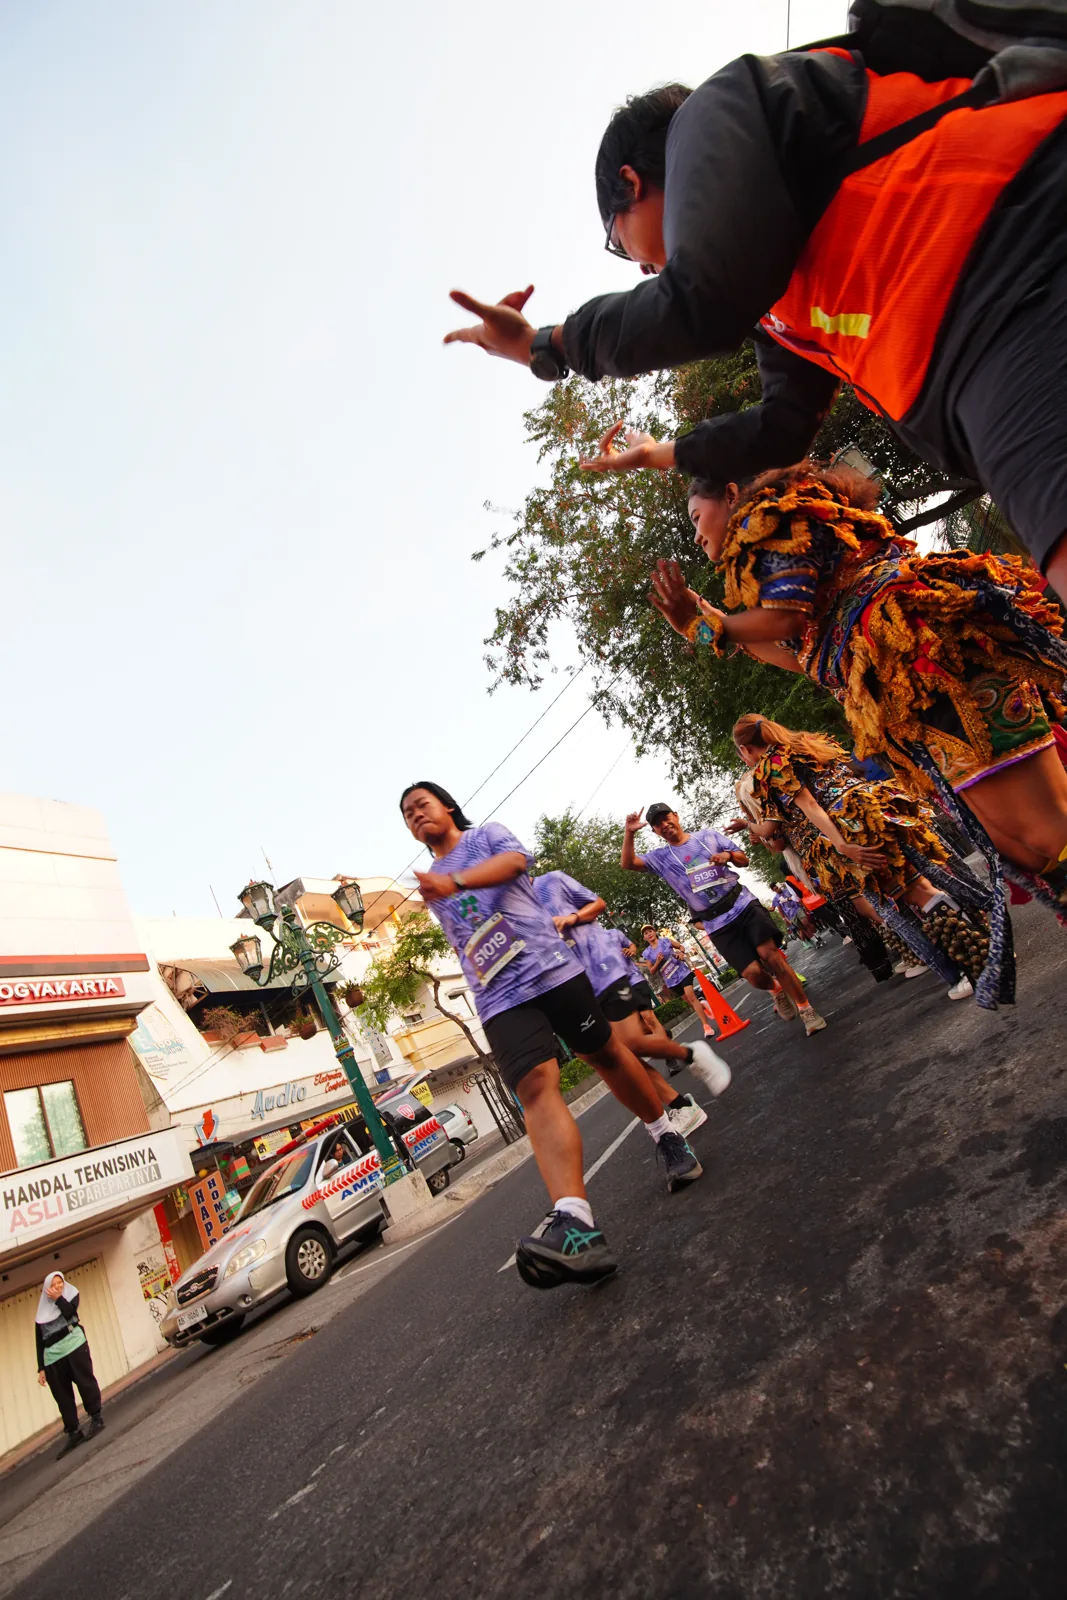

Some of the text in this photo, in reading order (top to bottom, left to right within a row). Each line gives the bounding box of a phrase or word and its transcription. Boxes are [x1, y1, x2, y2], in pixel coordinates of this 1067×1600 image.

[694, 868, 718, 883] 51361
[473, 931, 508, 967] 51019
[0, 978, 119, 999] OGYAKARTA
[251, 1082, 308, 1121] Audio
[3, 1147, 157, 1210] HANDAL TEKNISINYA
[9, 1164, 159, 1233] ASLI SPAREPARTNYA
